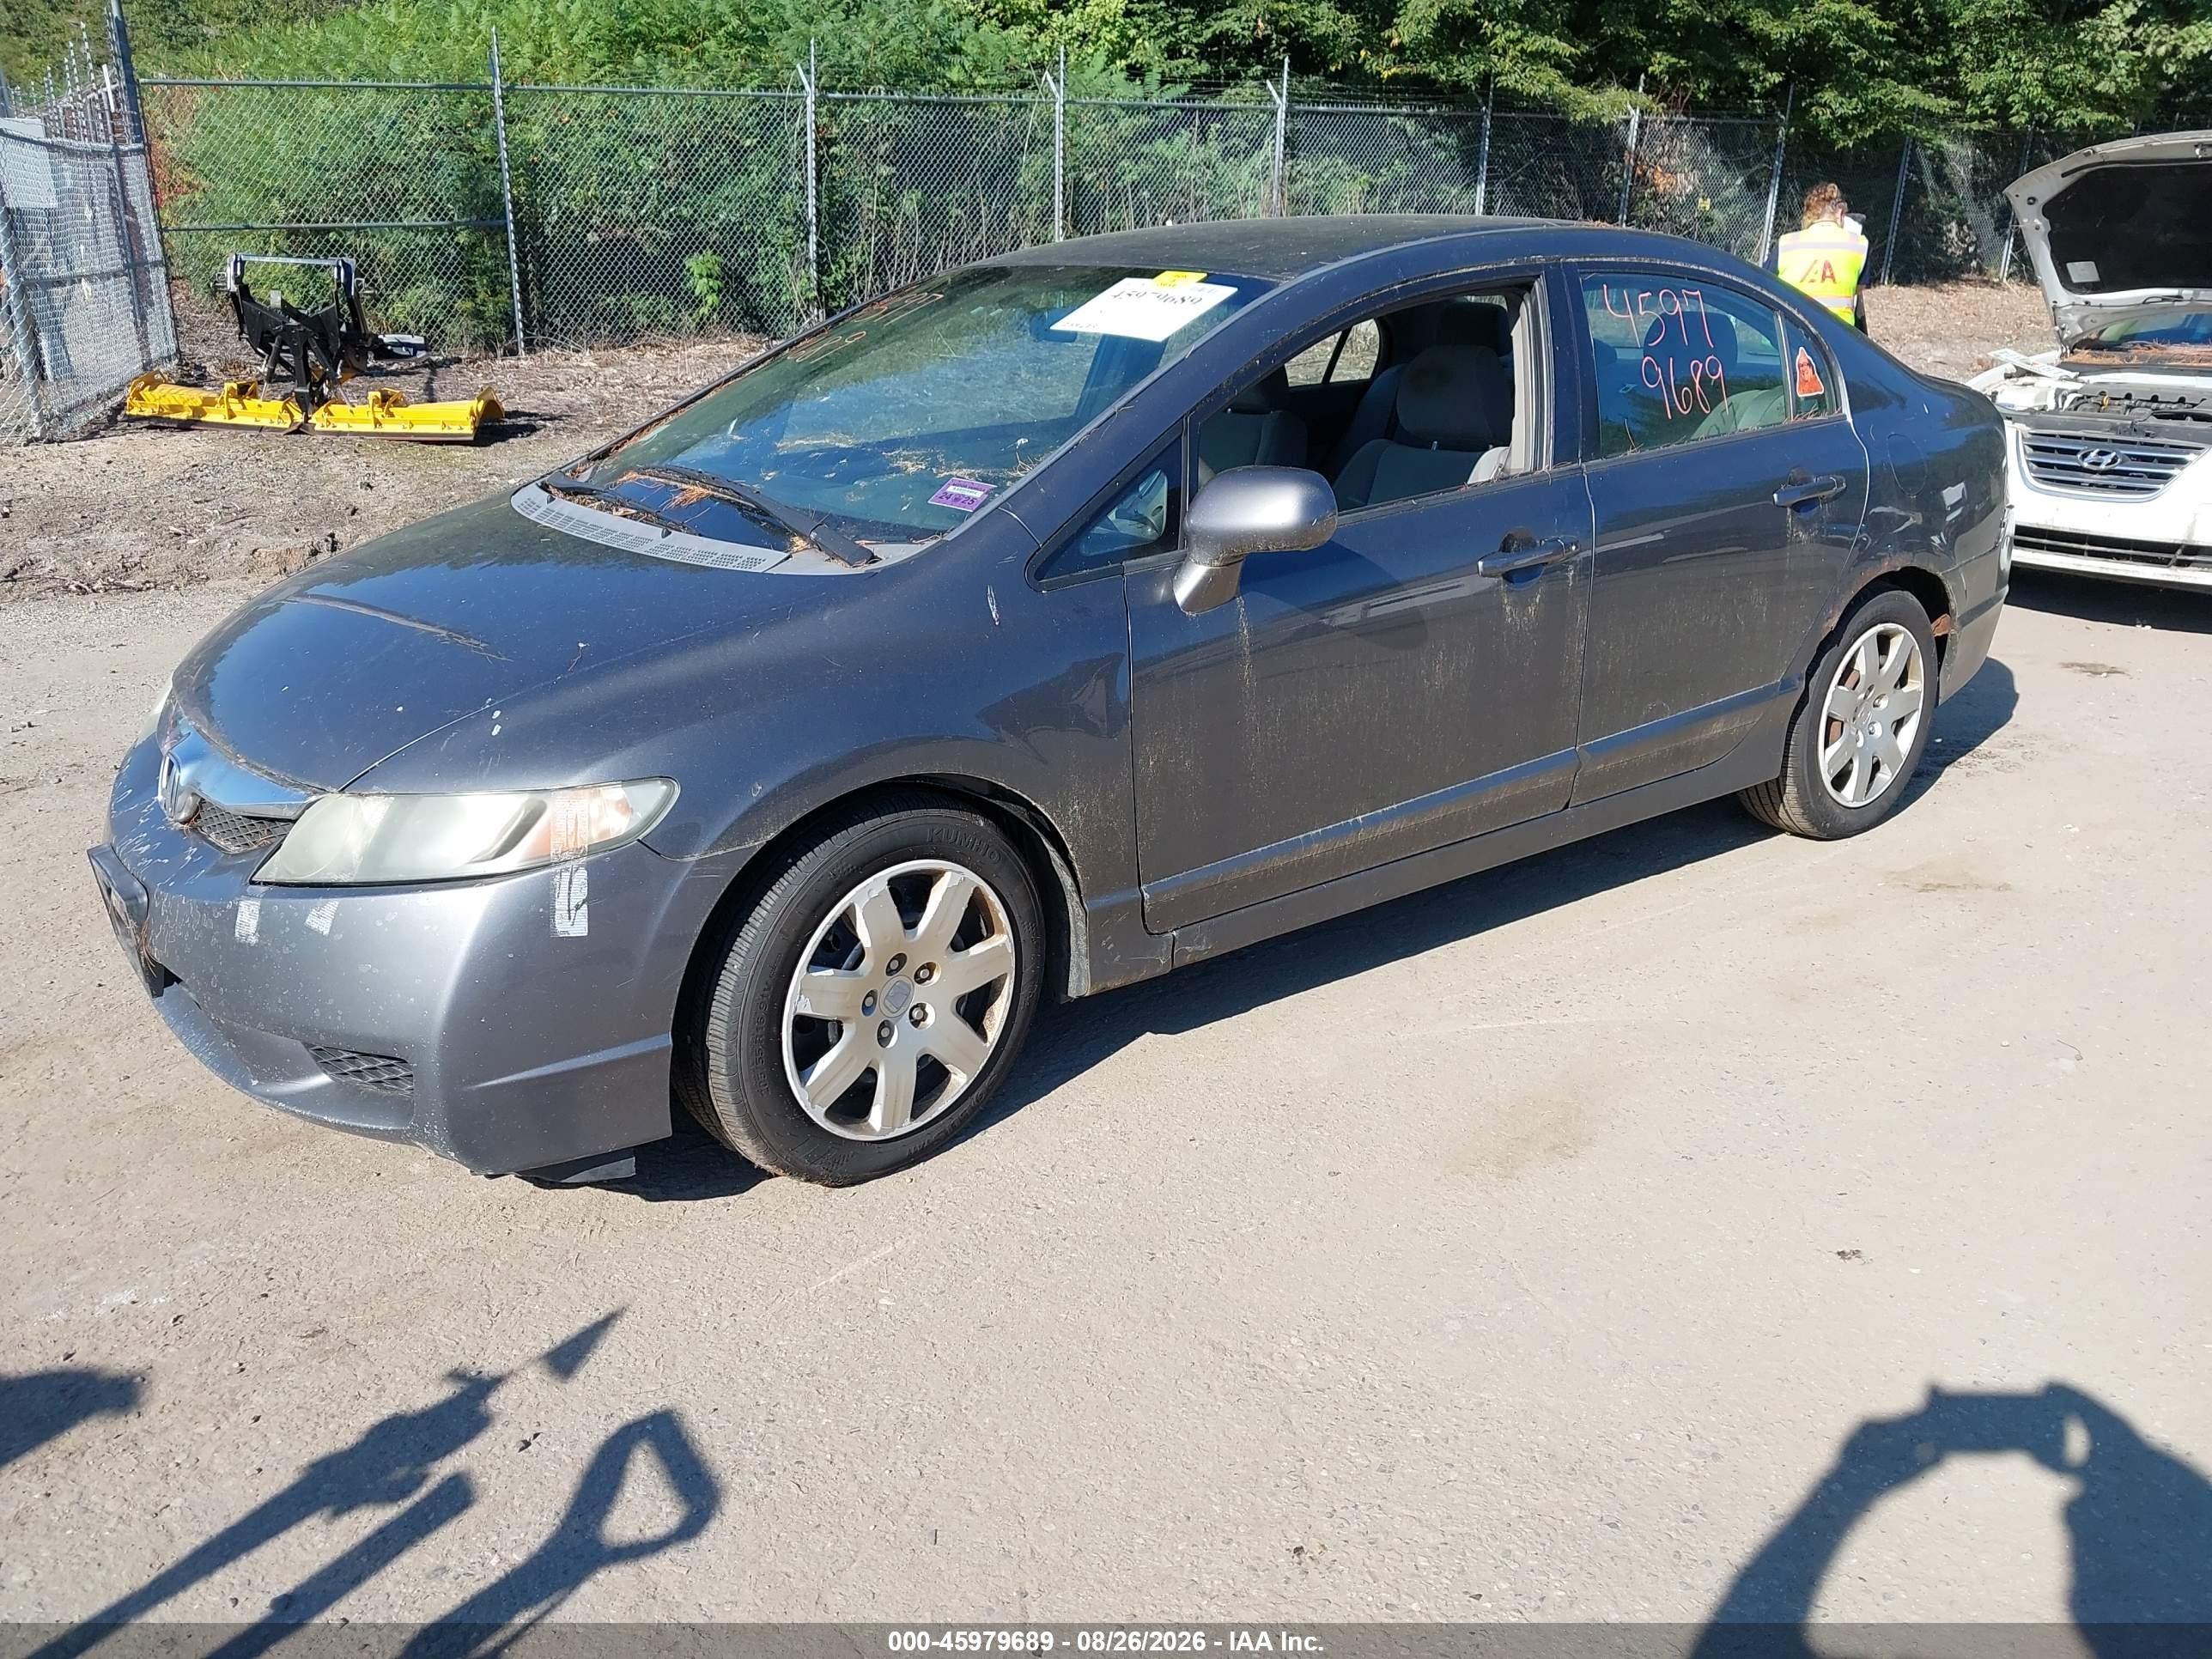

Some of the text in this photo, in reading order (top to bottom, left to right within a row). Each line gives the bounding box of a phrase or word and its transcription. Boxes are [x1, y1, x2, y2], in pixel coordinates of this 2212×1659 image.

[1602, 283, 1714, 349] 4597
[1641, 354, 1729, 419] 9689
[961, 496, 976, 505] 25
[927, 825, 1002, 862] KUMHO
